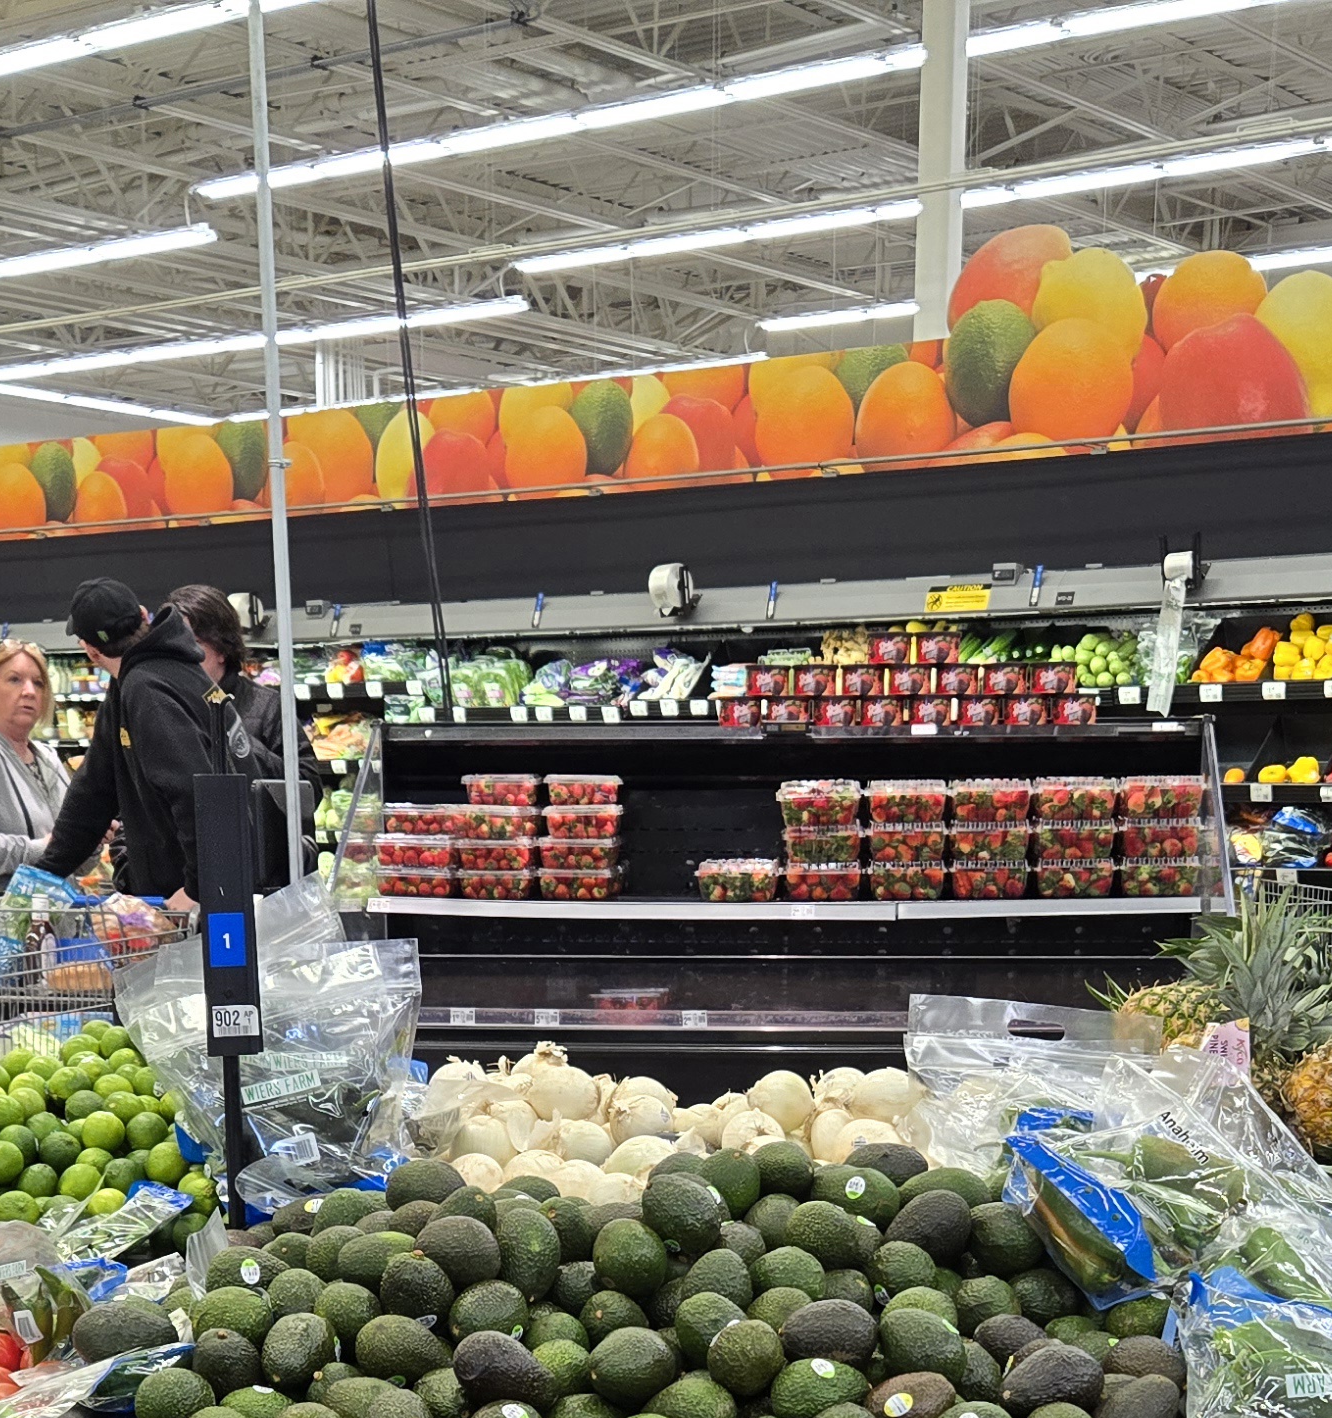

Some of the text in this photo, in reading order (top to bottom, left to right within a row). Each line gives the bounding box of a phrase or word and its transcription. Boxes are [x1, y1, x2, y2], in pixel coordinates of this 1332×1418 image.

[222, 932, 231, 949] 1
[215, 1009, 241, 1027] 902
[244, 1071, 317, 1102] WIERS FARM
[1160, 1110, 1210, 1166] Anaheim
